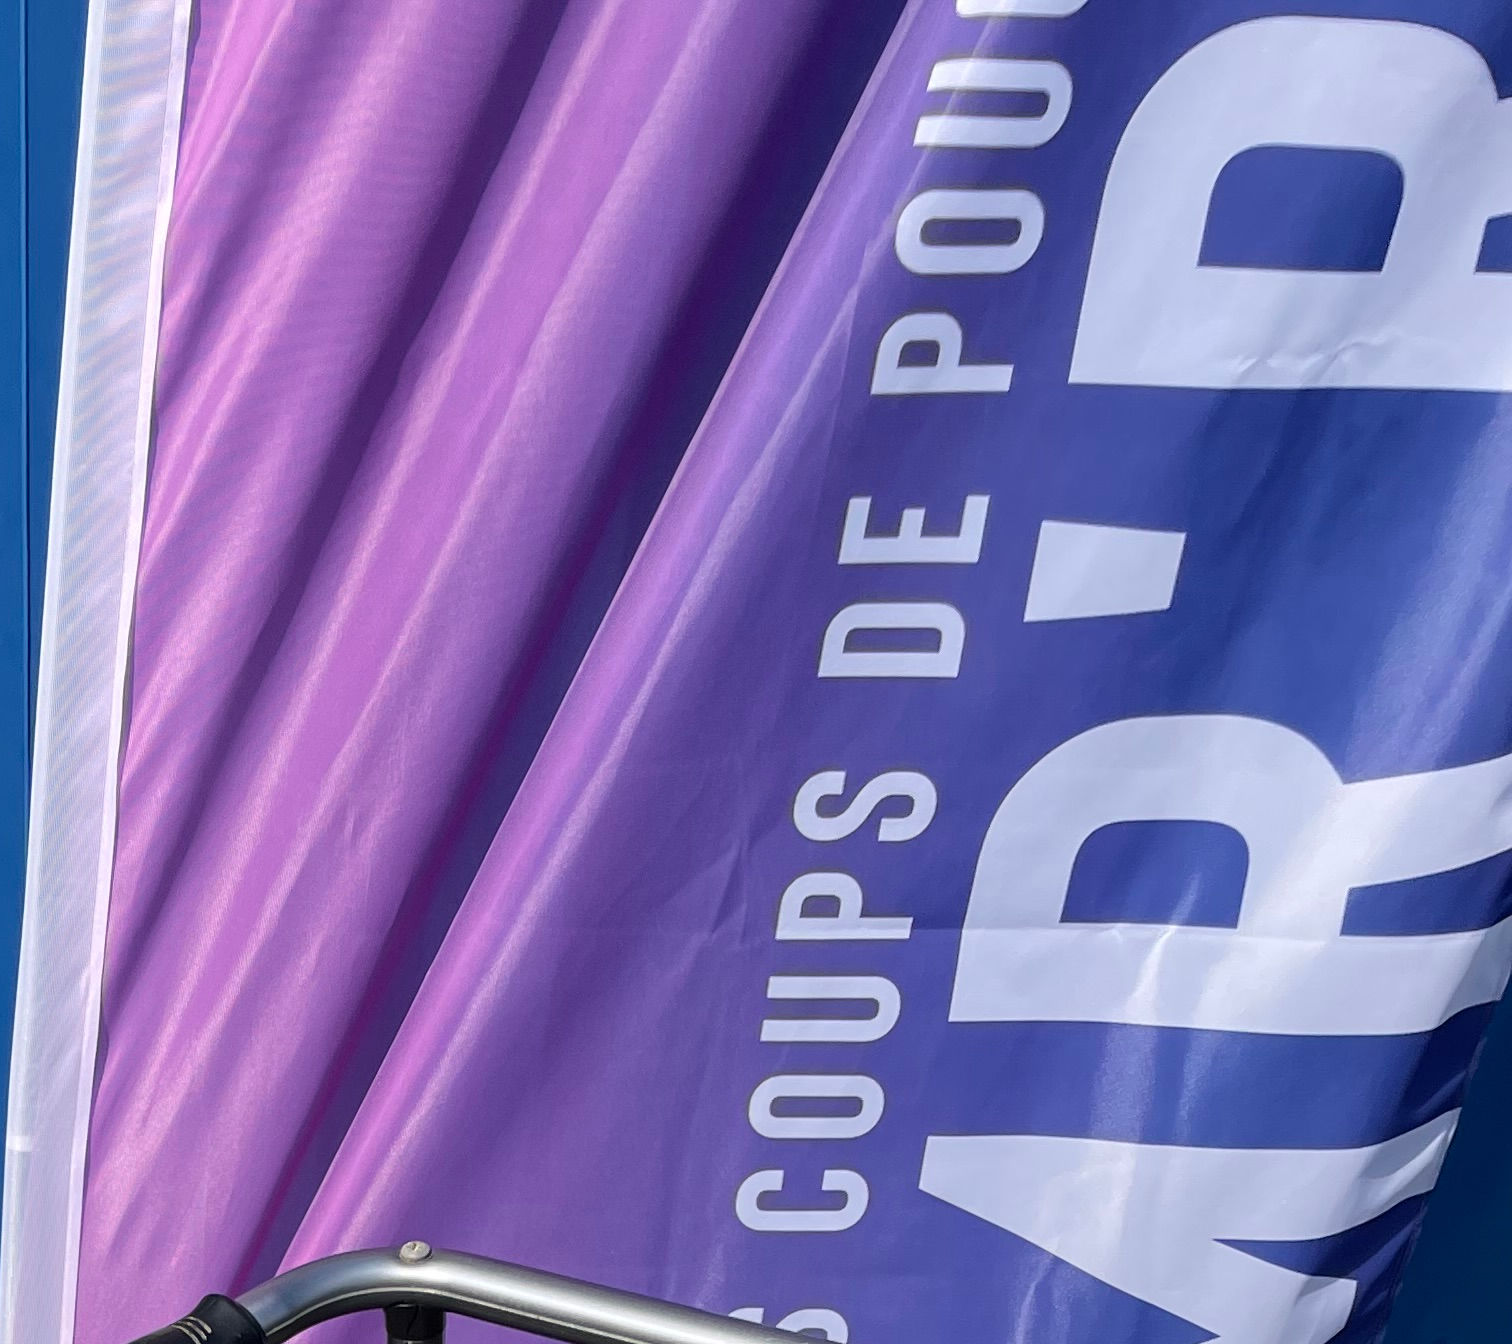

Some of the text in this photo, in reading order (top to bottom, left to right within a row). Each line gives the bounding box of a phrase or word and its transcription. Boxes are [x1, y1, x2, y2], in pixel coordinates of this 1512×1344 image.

[870, 0, 1089, 395] POU
[817, 494, 991, 678] DE
[735, 770, 938, 1232] COUPS
